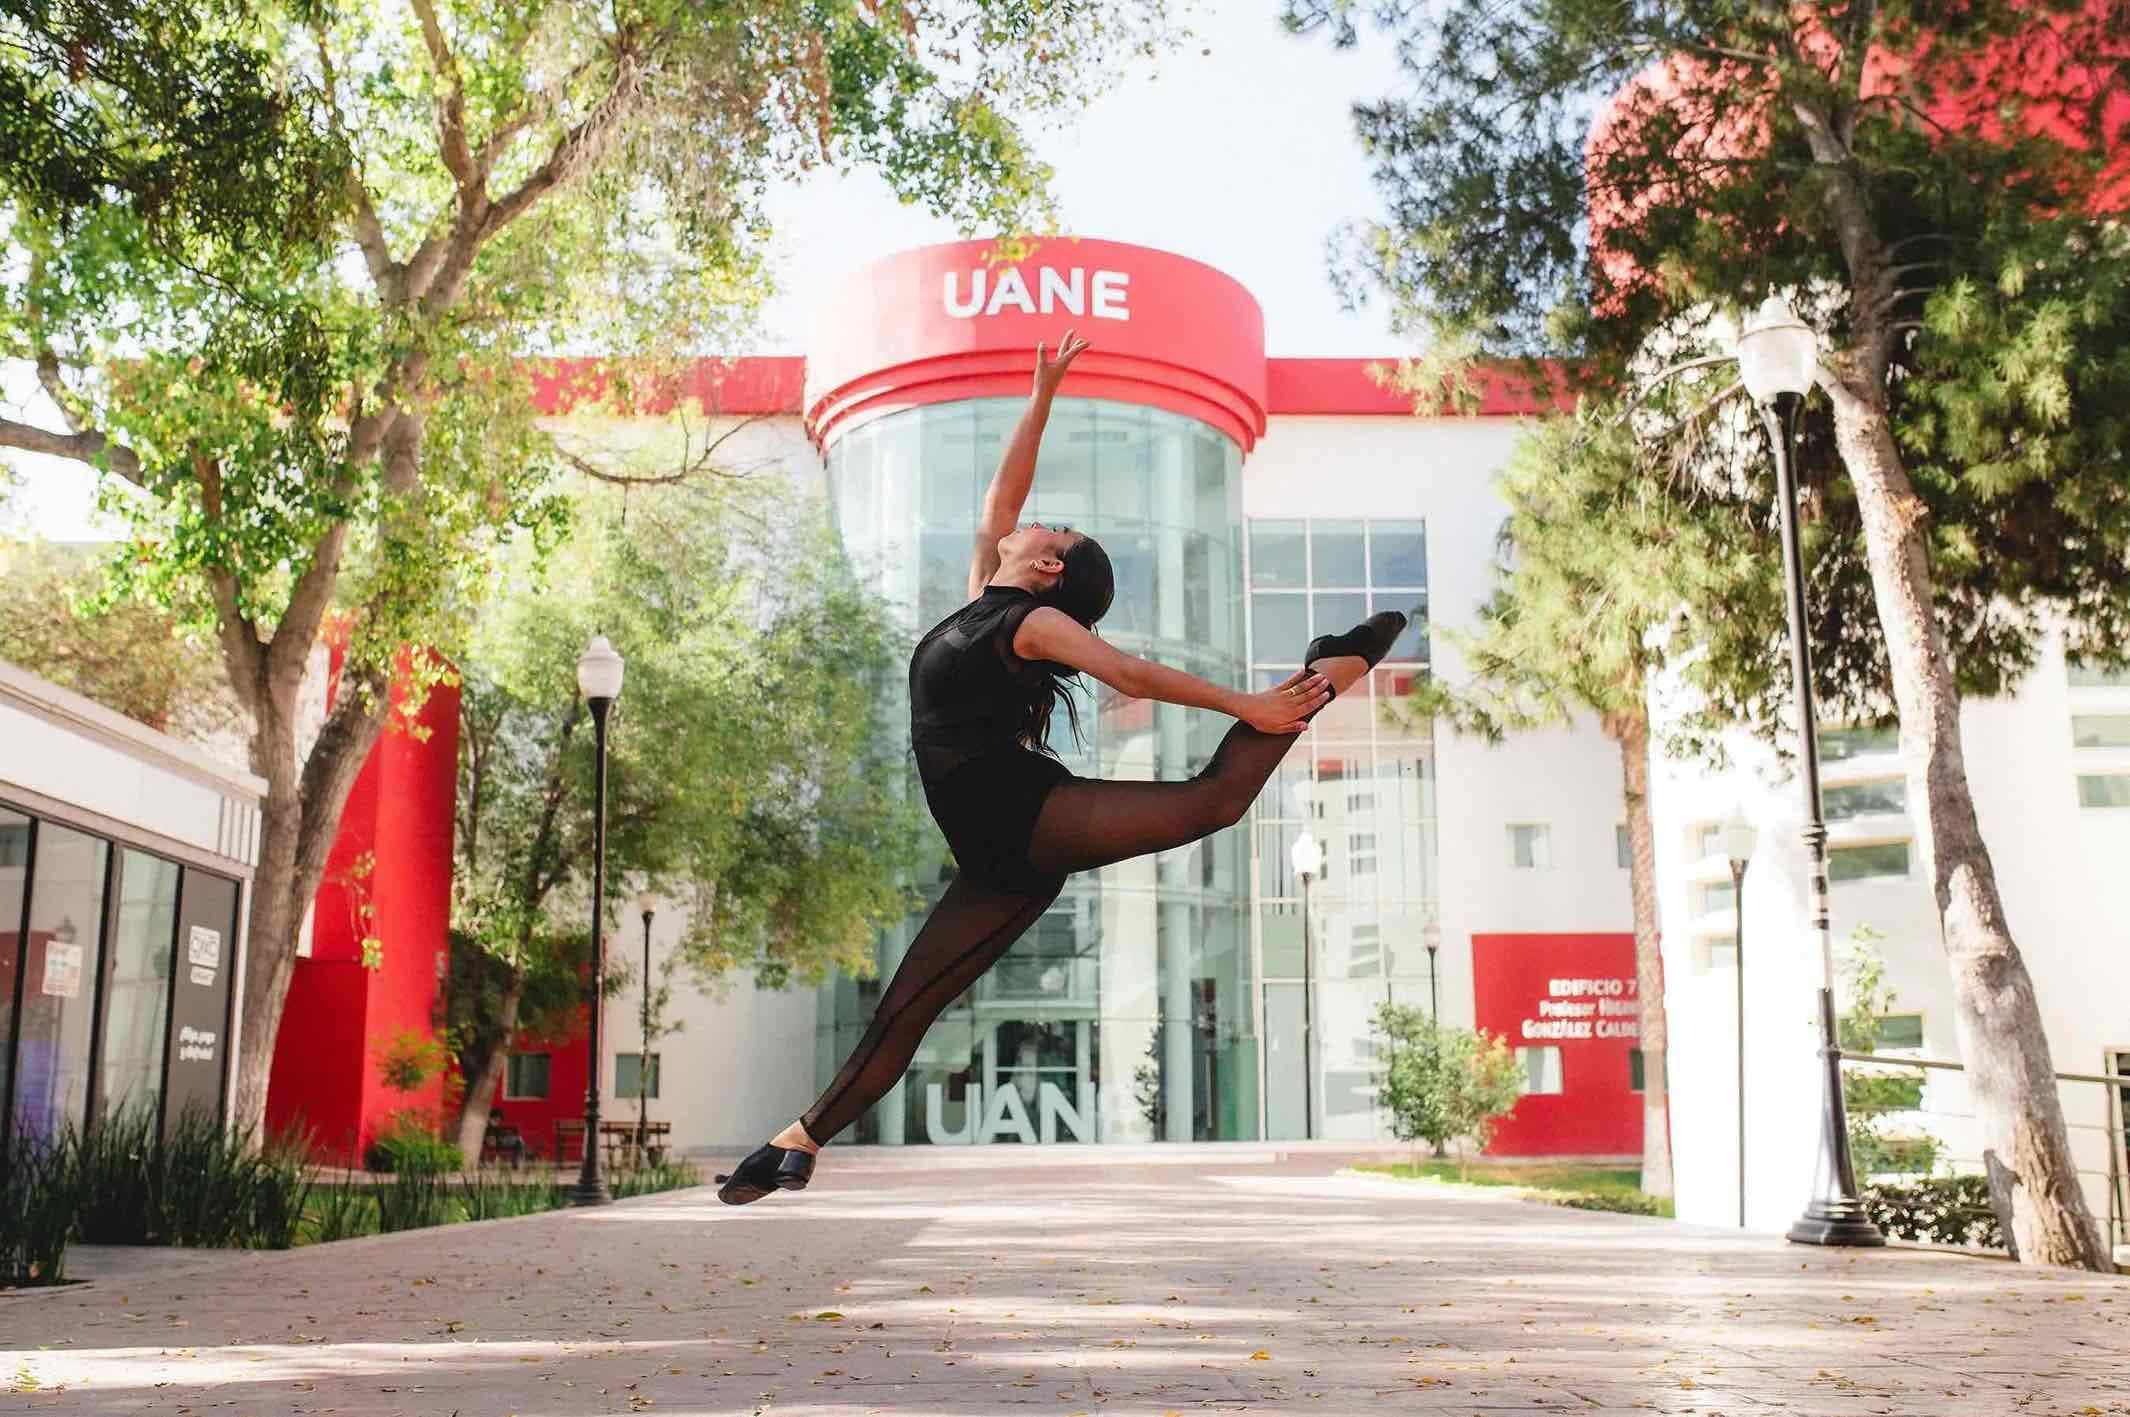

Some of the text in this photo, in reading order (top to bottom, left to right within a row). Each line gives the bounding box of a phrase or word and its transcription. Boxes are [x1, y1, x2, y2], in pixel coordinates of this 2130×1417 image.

[943, 266, 1130, 321] UANE
[1549, 978, 1623, 996] EDIFICIO
[926, 1082, 1104, 1145] UAN
